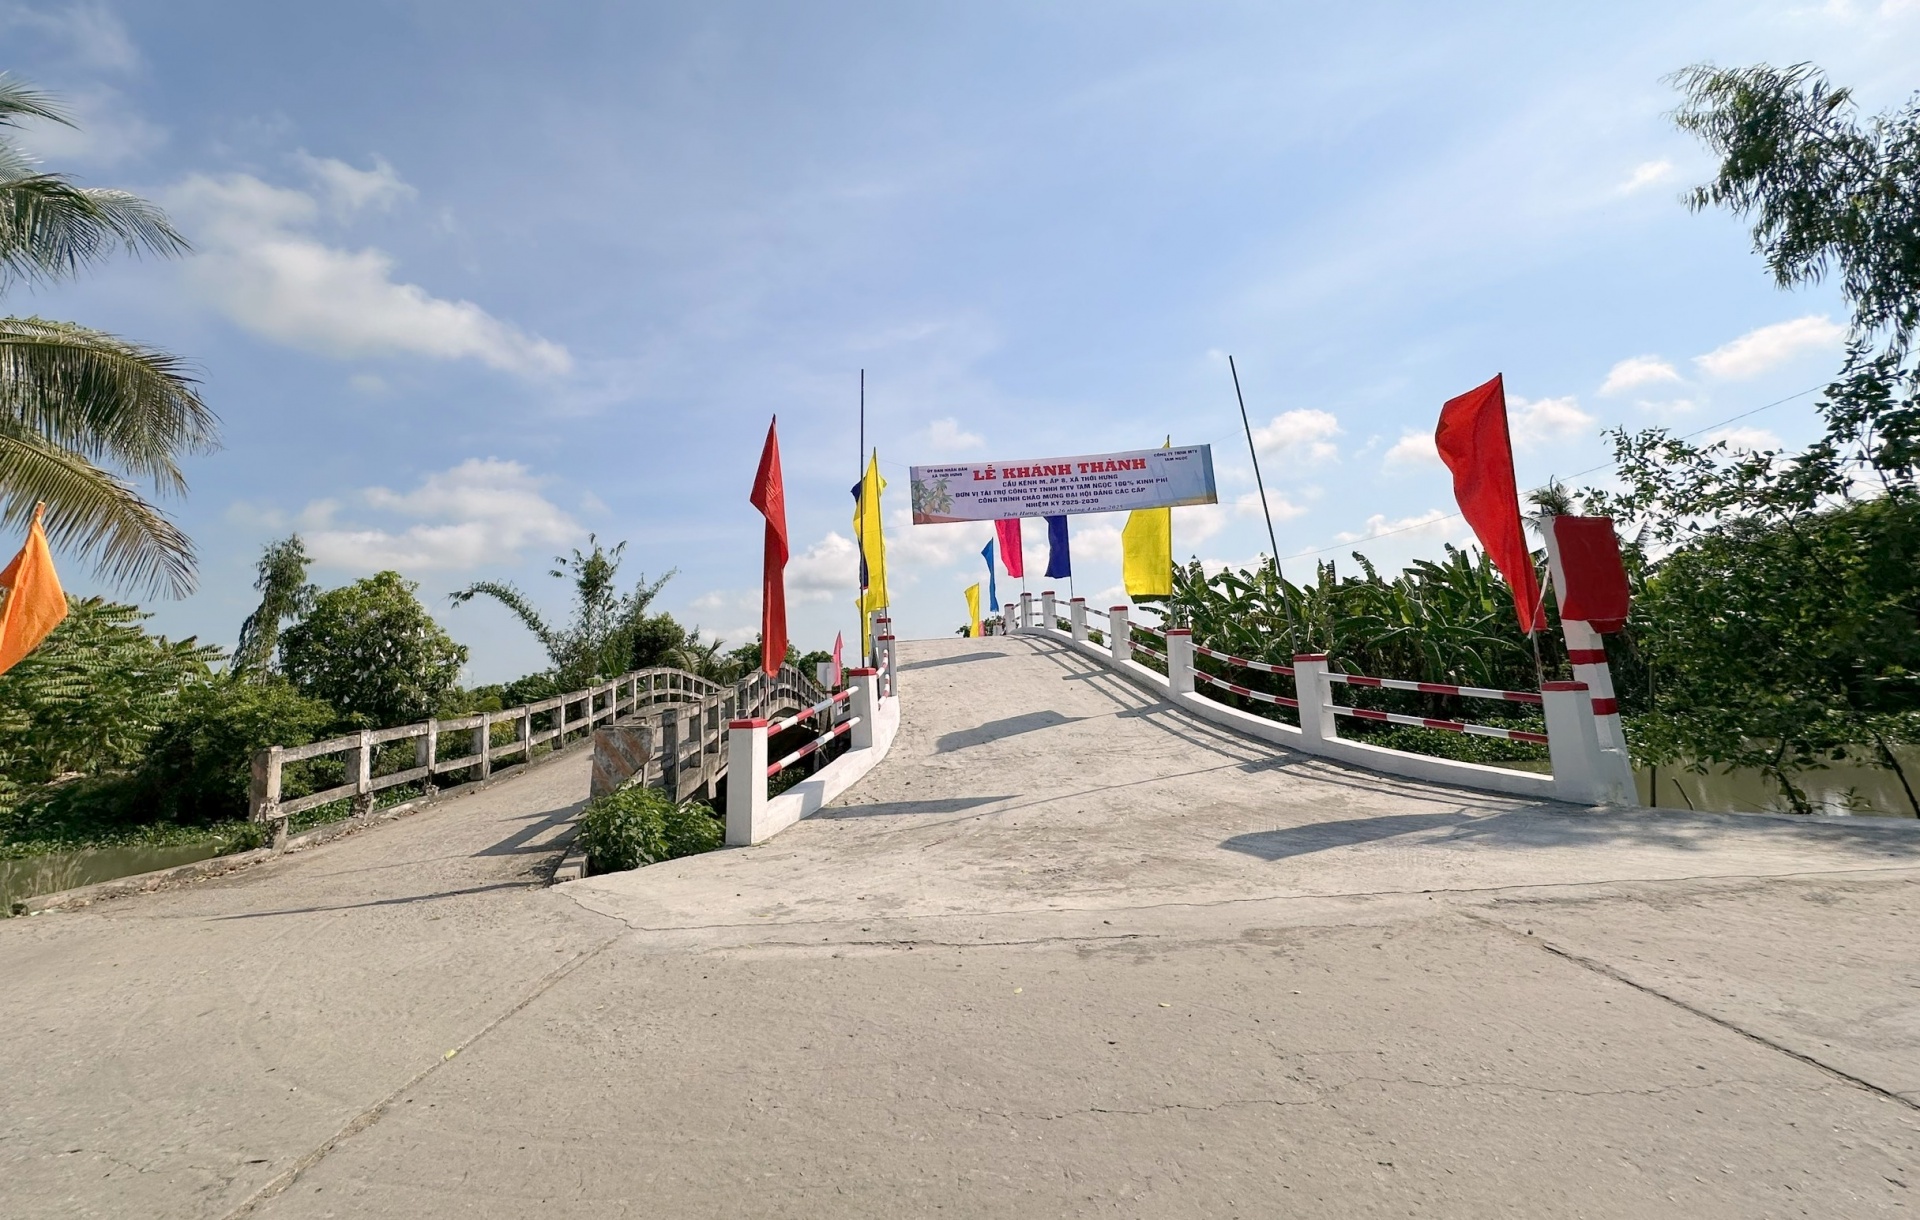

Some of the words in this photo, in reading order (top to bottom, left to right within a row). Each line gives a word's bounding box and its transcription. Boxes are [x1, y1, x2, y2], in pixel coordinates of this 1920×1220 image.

[973, 464, 997, 481] LỄ
[1002, 463, 1072, 479] KHÁNH
[1078, 458, 1147, 474] THÀNH
[1008, 487, 1028, 495] CÔNG
[1092, 481, 1112, 490] NGỌC
[1114, 480, 1135, 488] 100%
[1136, 478, 1154, 486] KINH
[1018, 478, 1037, 487] KÊNH
[978, 496, 998, 504] CÔNG
[1115, 487, 1130, 495] CÁC
[1061, 498, 1099, 506] 2025-2030
